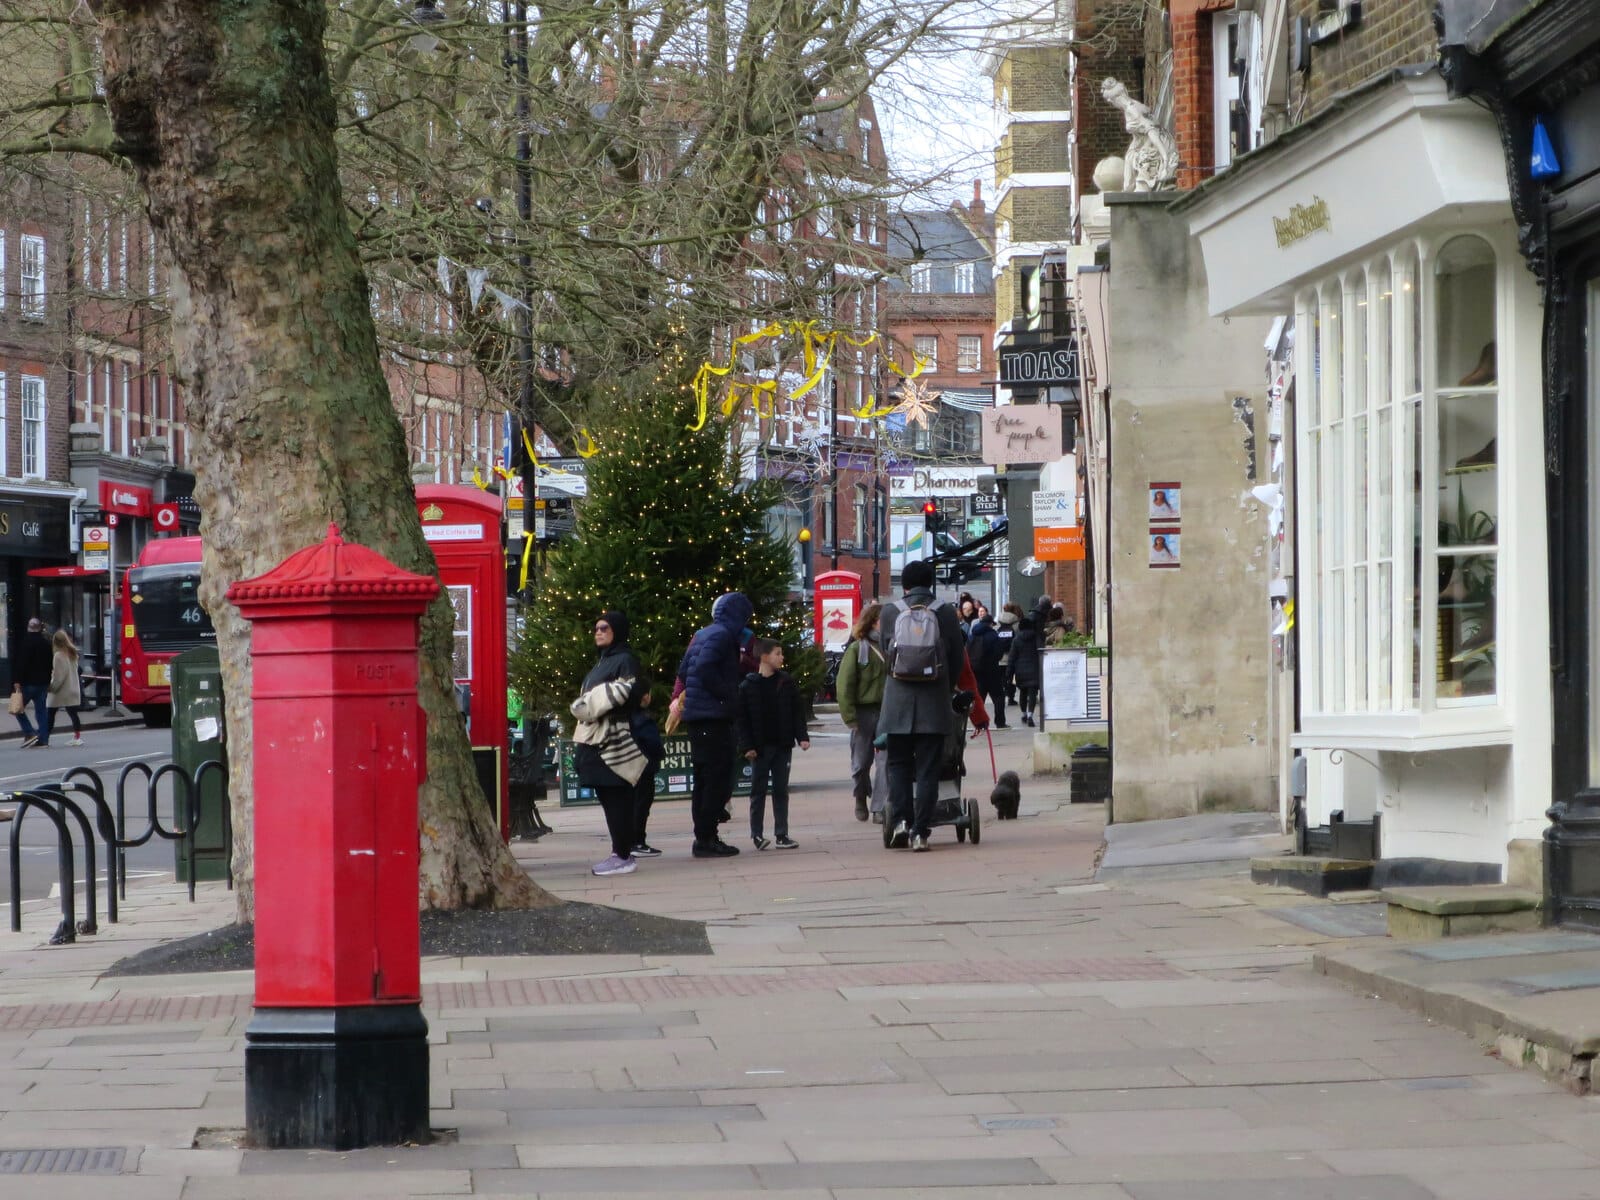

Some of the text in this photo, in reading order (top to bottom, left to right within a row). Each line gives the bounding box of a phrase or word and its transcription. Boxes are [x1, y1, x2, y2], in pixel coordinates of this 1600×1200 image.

[991, 413, 1025, 434] free
[1006, 425, 1049, 450] people
[561, 463, 585, 471] CCTV
[914, 470, 977, 491] Pharmac
[109, 513, 117, 525] B
[22, 521, 40, 537] Café
[1038, 545, 1058, 553] Local
[181, 607, 201, 623] 46
[356, 664, 396, 681] POST
